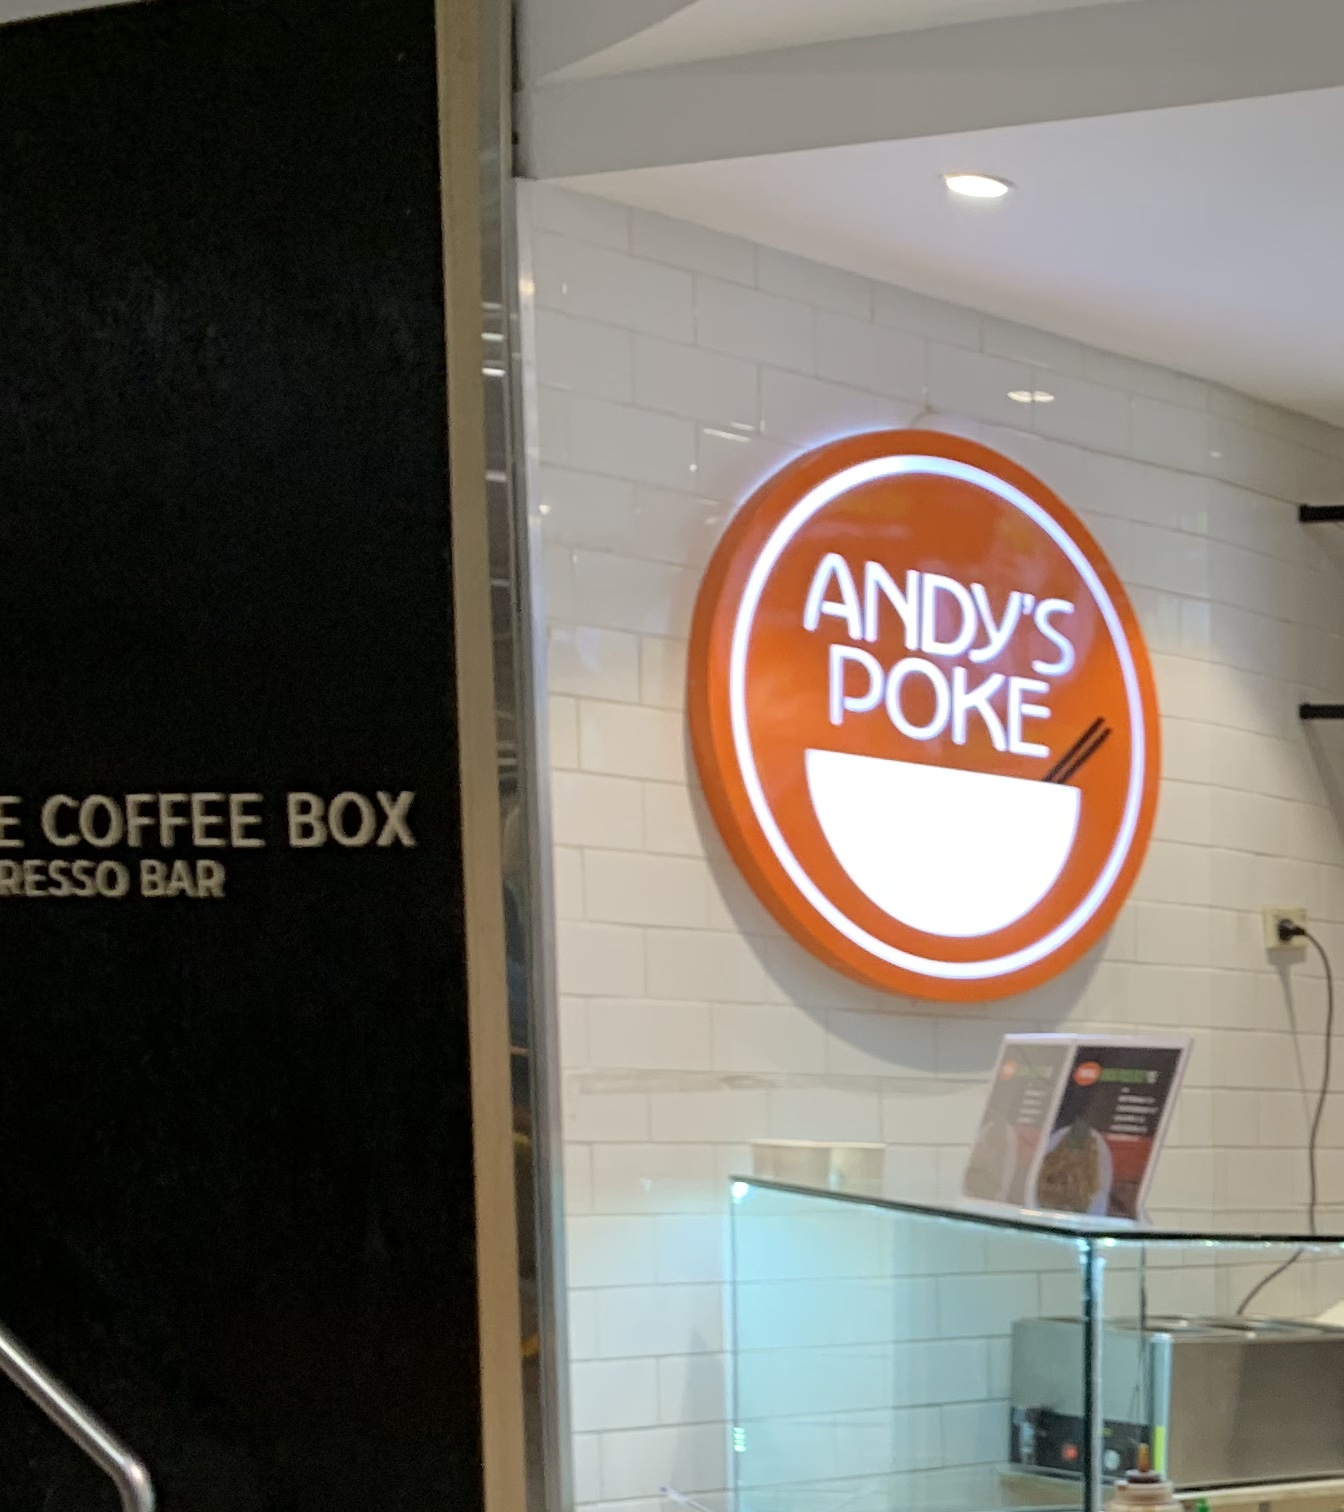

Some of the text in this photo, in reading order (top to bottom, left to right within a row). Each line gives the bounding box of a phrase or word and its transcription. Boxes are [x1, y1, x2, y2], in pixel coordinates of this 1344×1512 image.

[803, 552, 1075, 678] ANDY'S
[829, 644, 1051, 758] POKE
[0, 790, 418, 849] E COFFEE BOX
[0, 858, 227, 899] RESSO BAR
